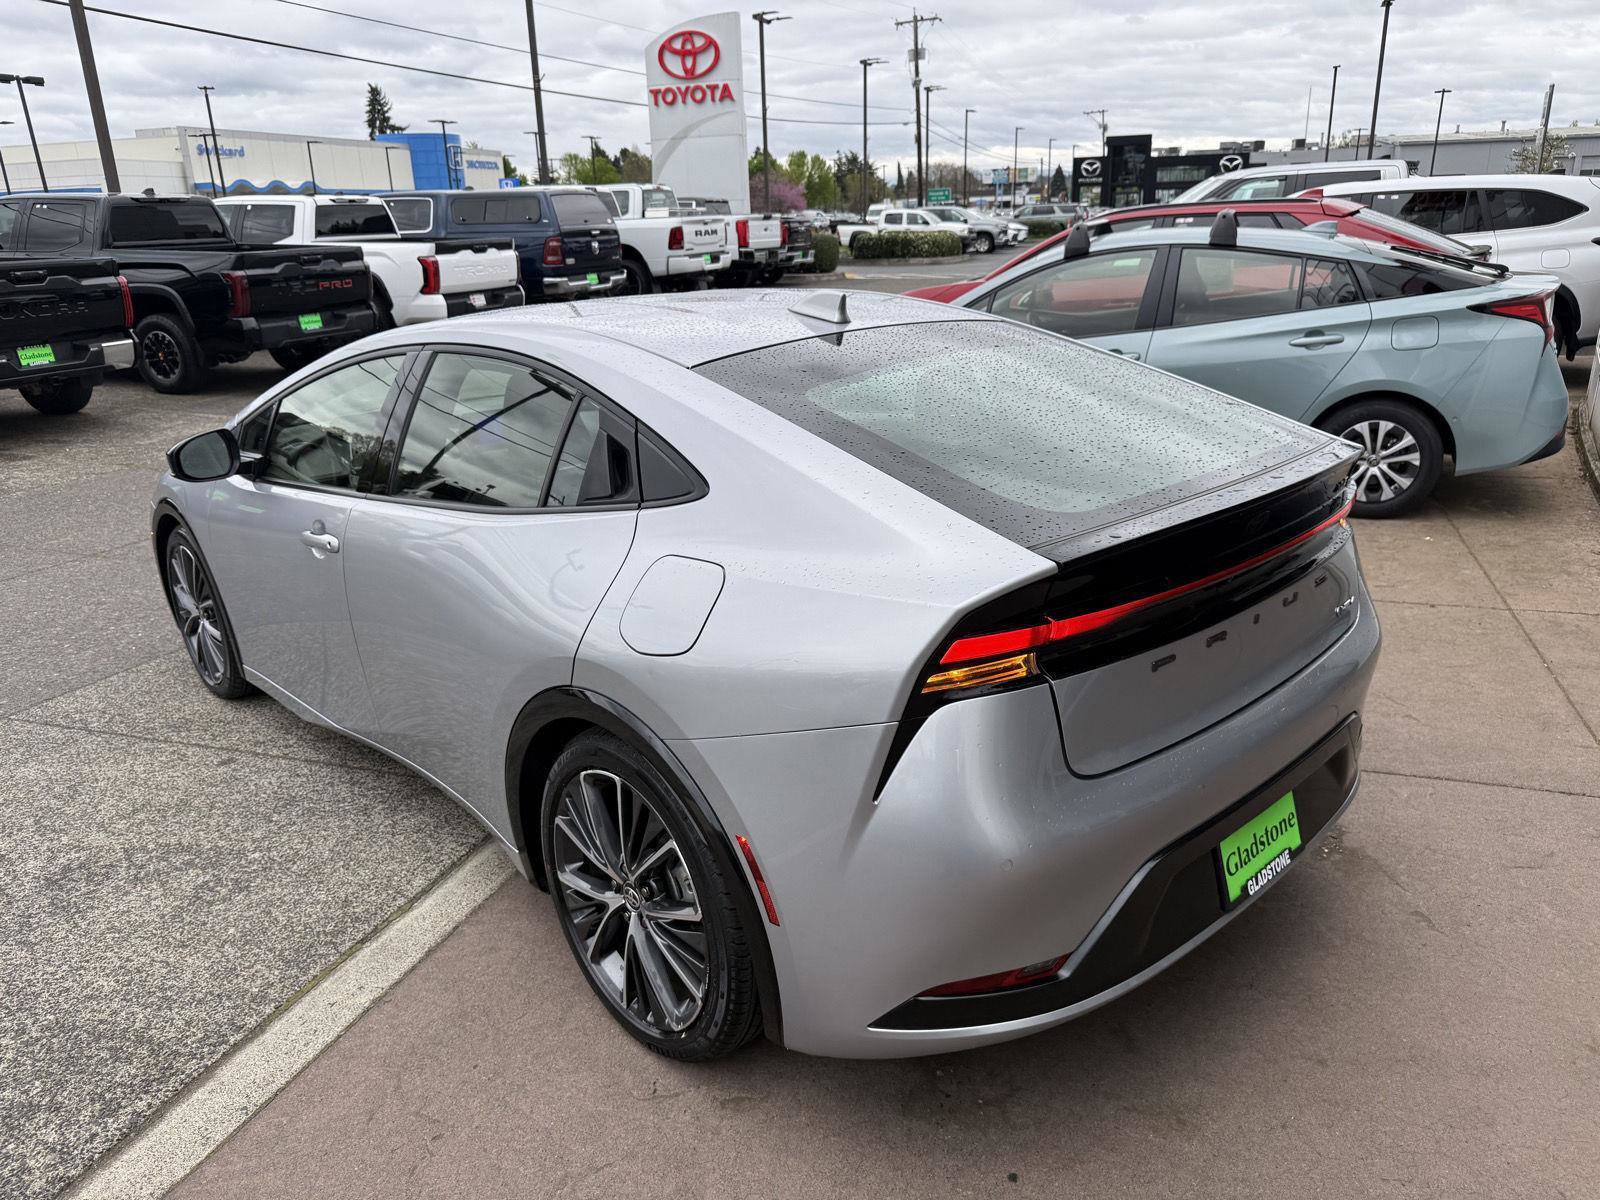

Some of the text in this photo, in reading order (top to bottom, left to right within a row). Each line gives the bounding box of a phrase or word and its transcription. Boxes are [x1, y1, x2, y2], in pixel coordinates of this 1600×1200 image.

[649, 83, 735, 107] TOYOTA
[694, 229, 718, 237] RAM
[319, 279, 353, 290] PRO
[1225, 811, 1295, 877] Gladstone
[1247, 849, 1291, 896] GLADSTONE
